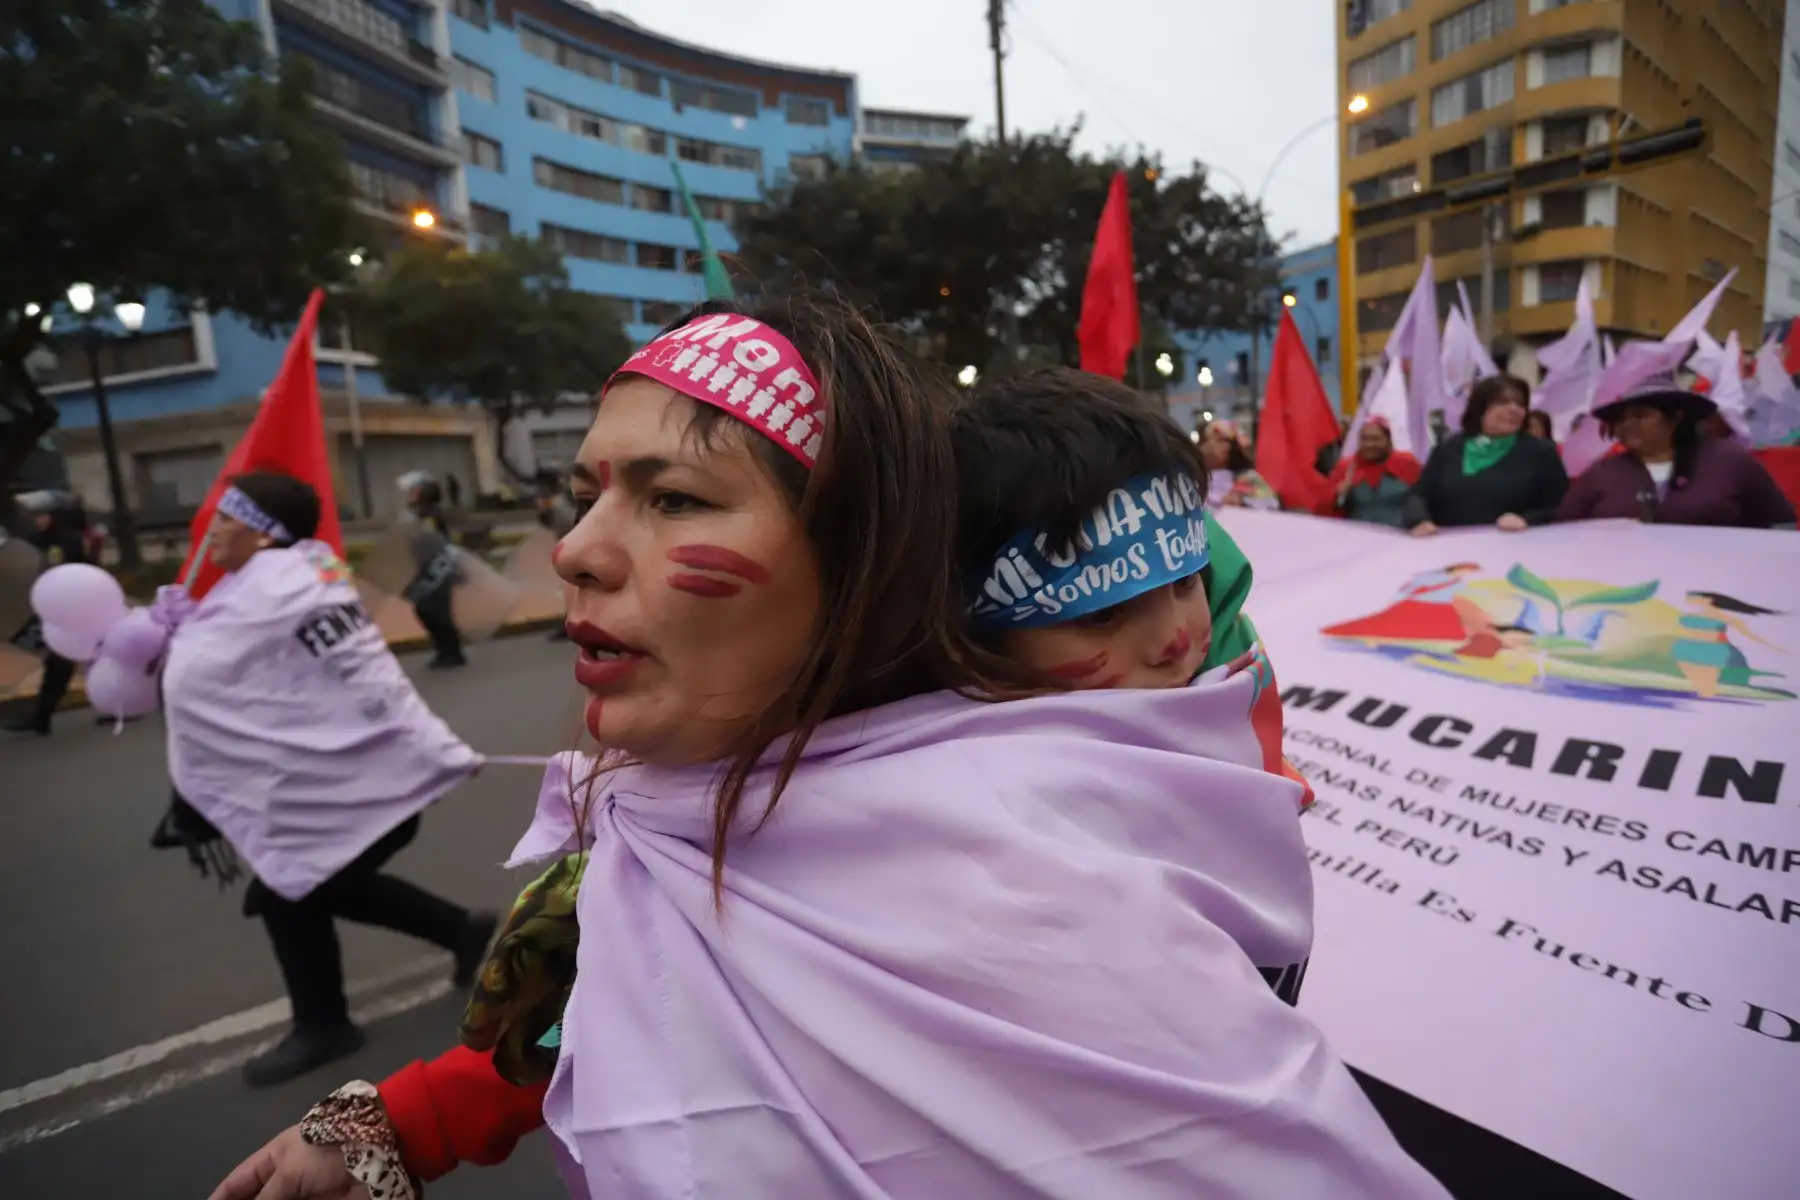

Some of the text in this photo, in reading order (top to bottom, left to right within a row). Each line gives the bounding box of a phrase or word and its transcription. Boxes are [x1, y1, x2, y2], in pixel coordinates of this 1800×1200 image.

[1280, 685, 1800, 808] MUCARIN
[1283, 730, 1393, 777] CIONAL
[1404, 767, 1452, 794] DE
[1458, 784, 1648, 841] MUJERES
[1354, 819, 1460, 867] PERÚ
[1387, 796, 1545, 857] NATIVAS
[1563, 846, 1590, 867] Y
[1413, 888, 1476, 924] Es
[1494, 916, 1712, 1013] Fuente
